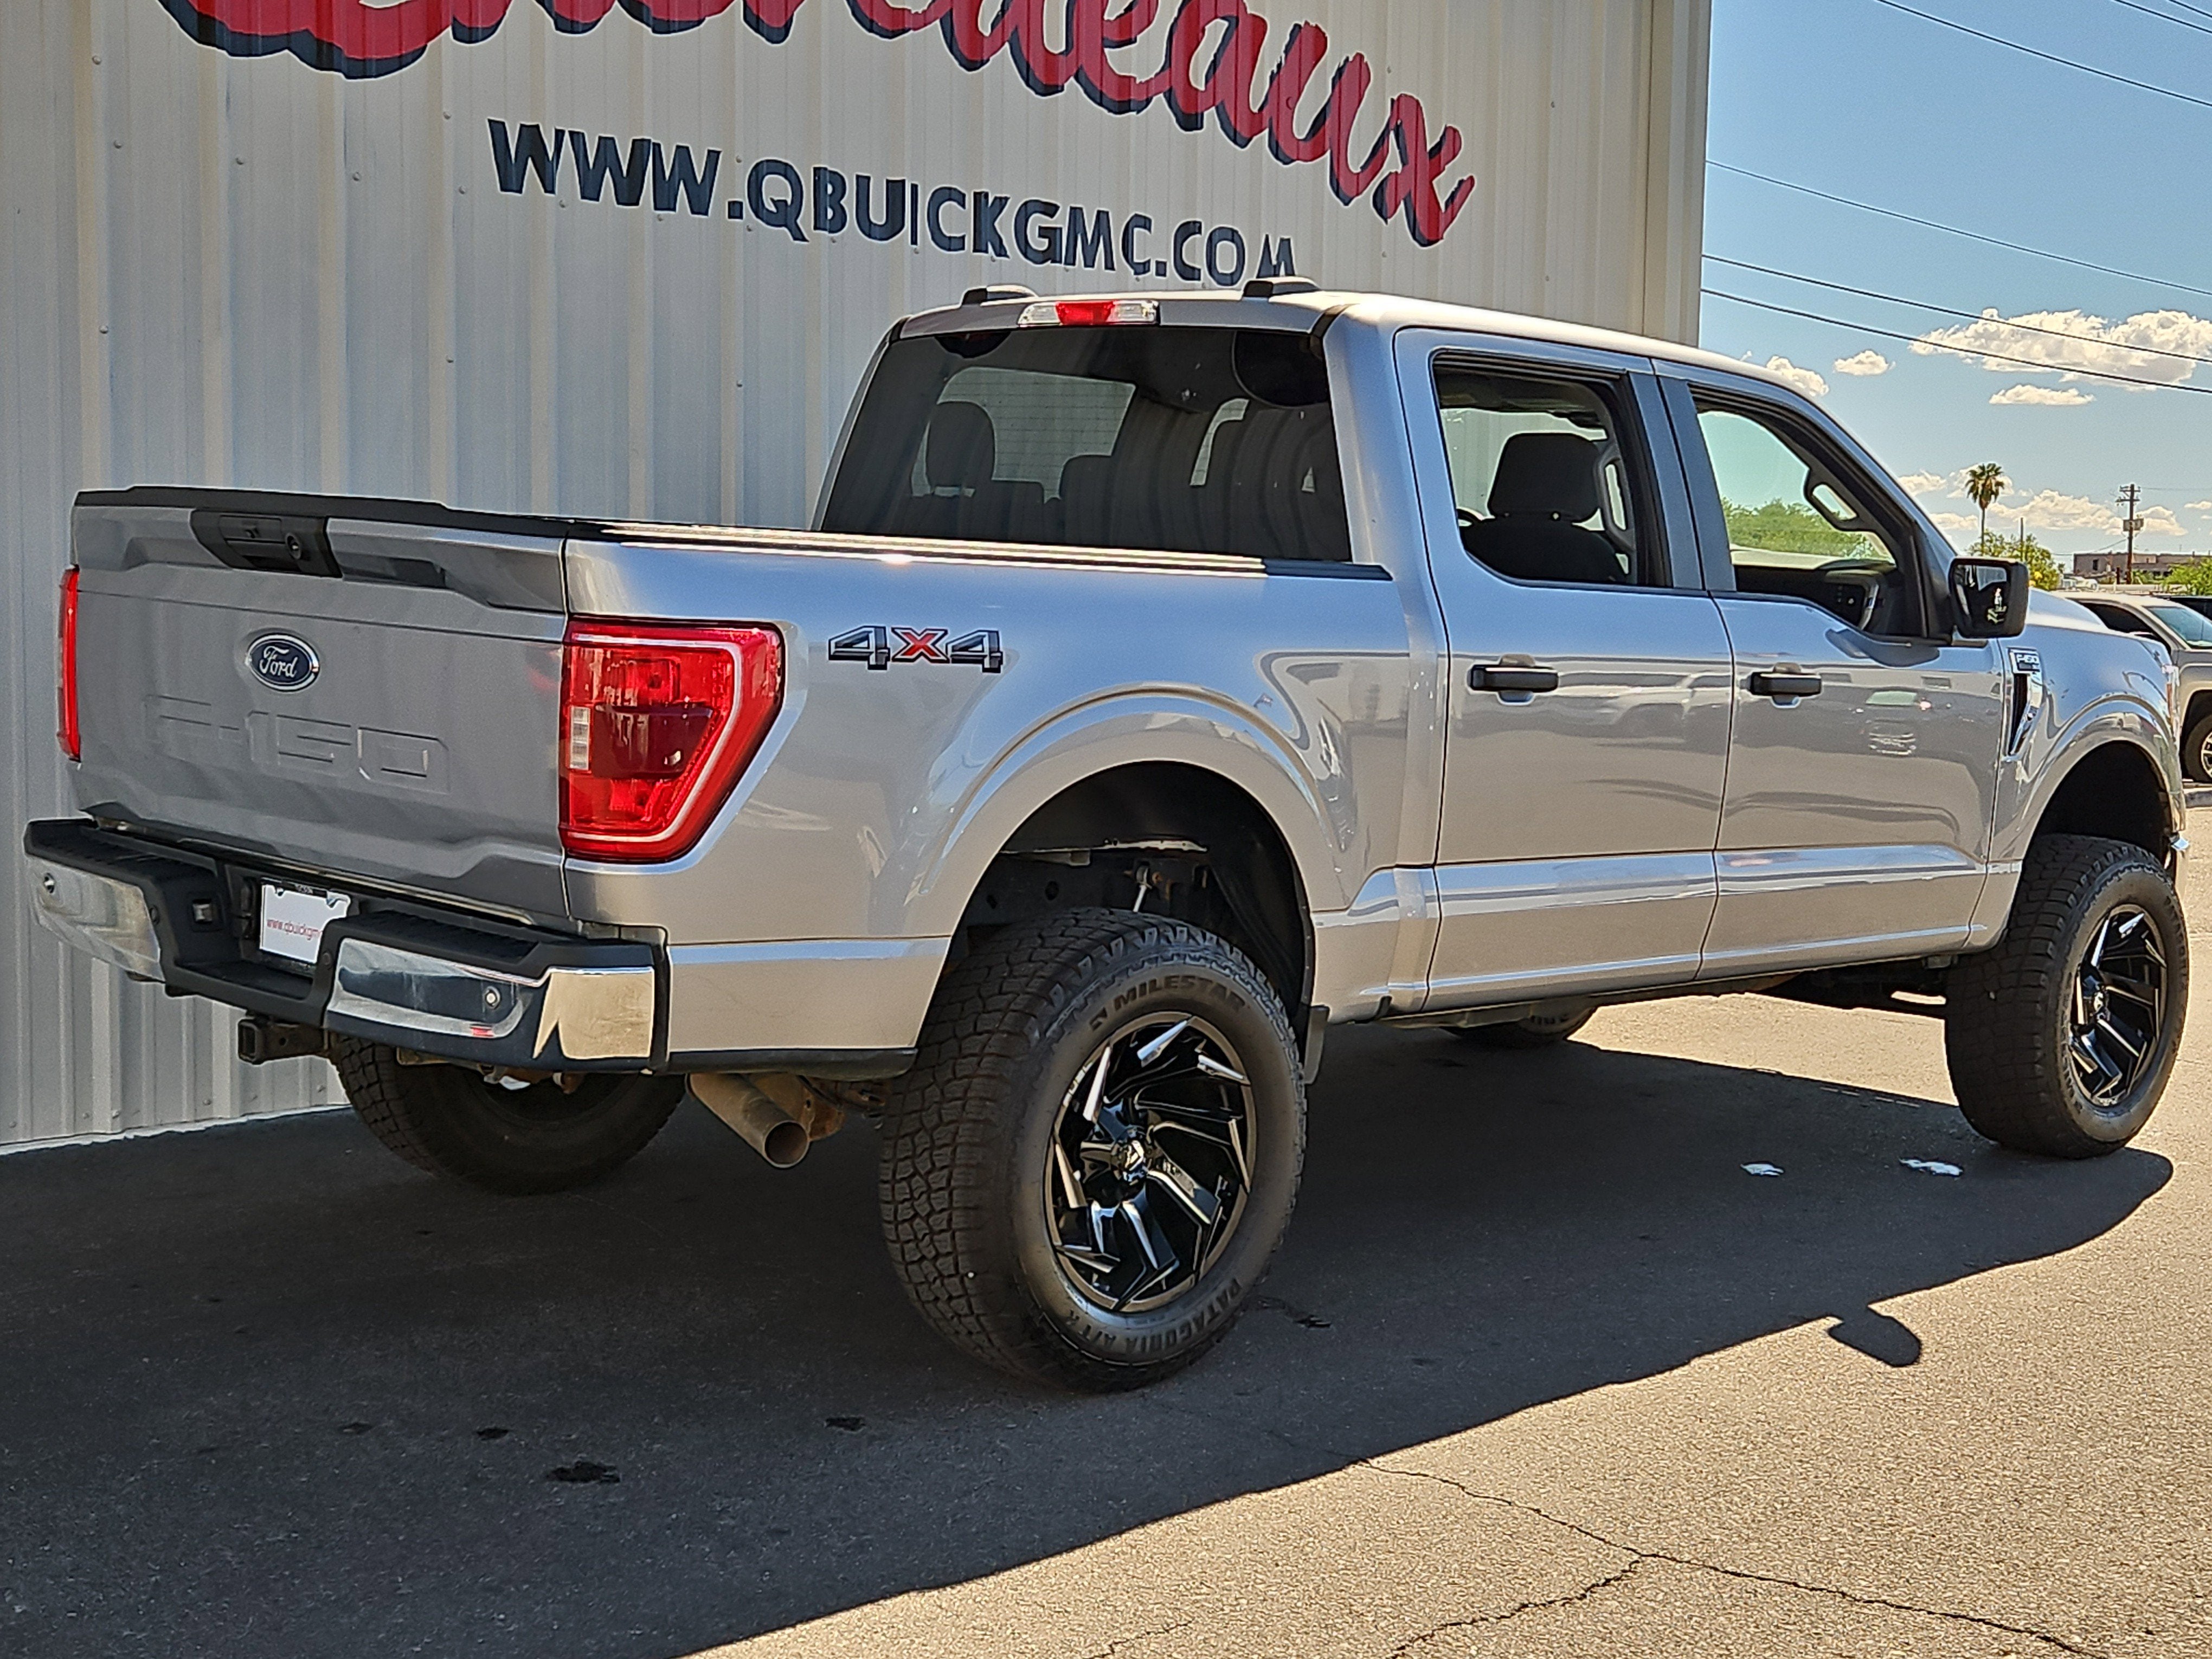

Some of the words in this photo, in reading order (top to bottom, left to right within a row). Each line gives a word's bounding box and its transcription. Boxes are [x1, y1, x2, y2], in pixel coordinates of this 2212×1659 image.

[487, 117, 1296, 287] WWW.QBUICKGMC.COM
[259, 646, 298, 678] Ford
[1114, 975, 1246, 1011] MILESTAR
[1124, 1278, 1243, 1354] PATAGONIA
